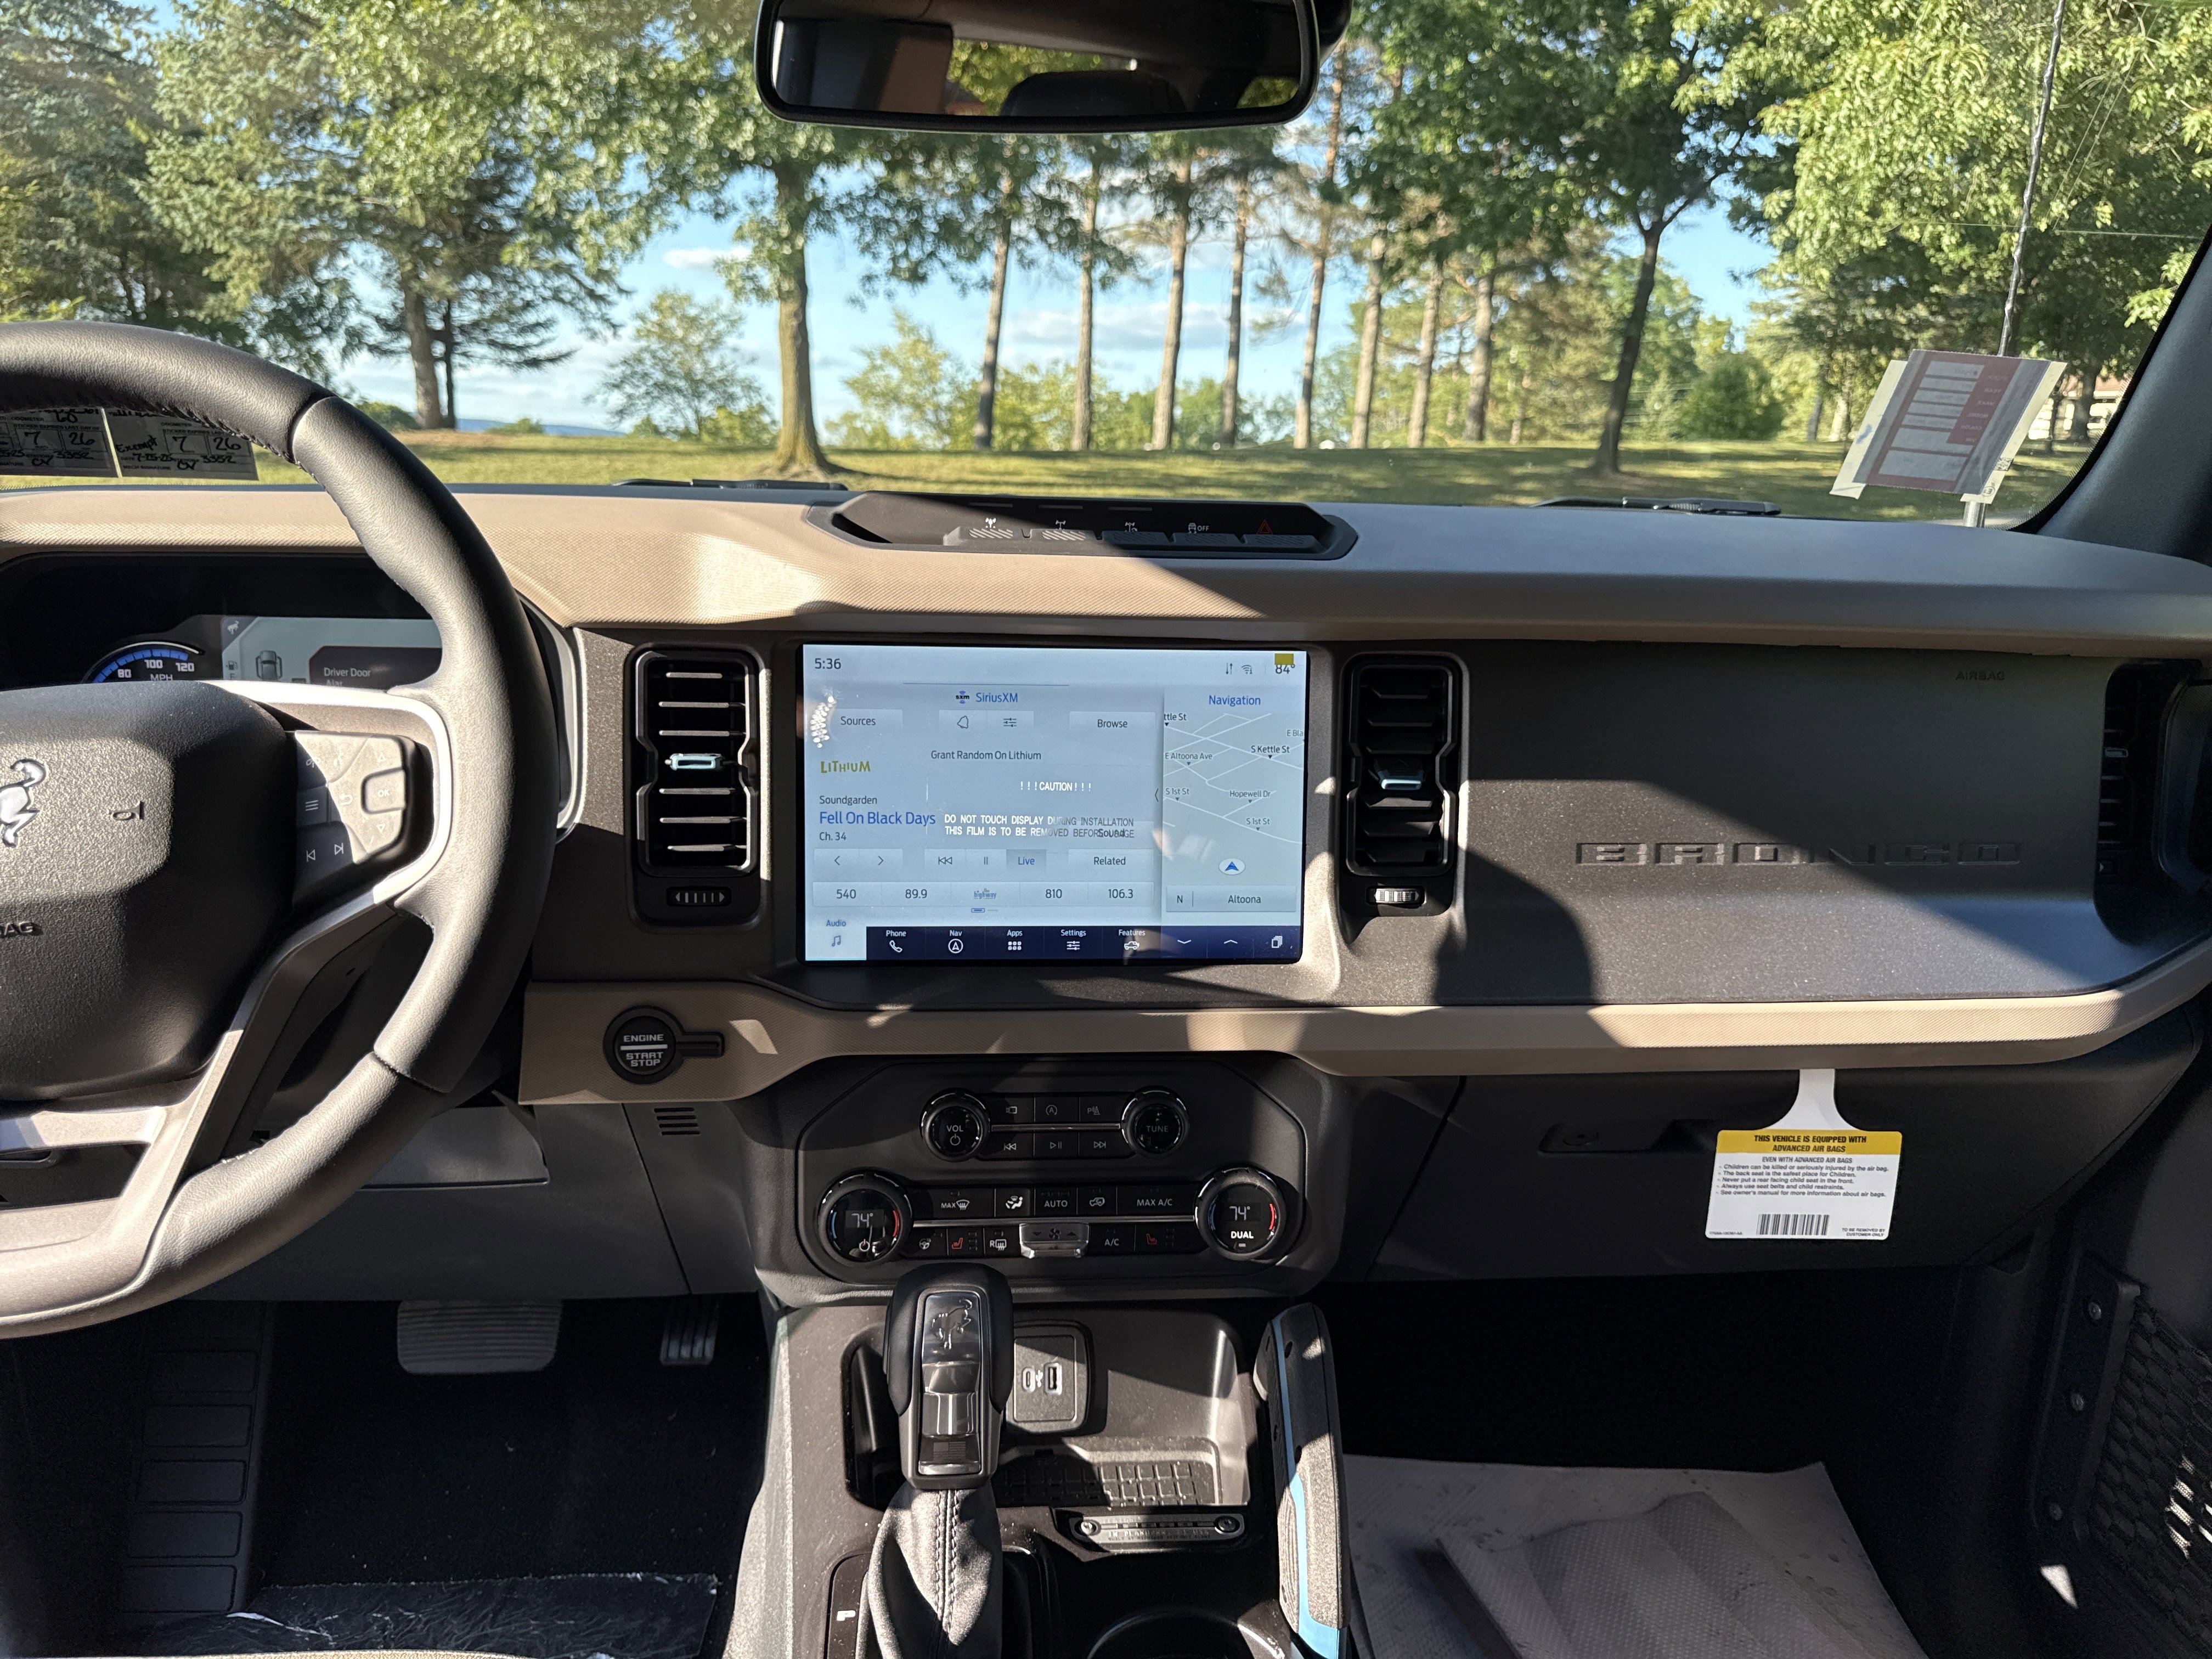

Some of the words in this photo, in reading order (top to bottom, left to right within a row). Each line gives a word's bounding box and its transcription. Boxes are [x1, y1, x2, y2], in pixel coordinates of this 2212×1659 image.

[213, 437, 241, 451] 26
[144, 659, 163, 669] 100
[176, 663, 195, 672] 120
[814, 658, 842, 670] 5:36
[117, 669, 132, 678] 80
[324, 667, 348, 676] Driver
[351, 668, 371, 677] Door
[975, 692, 1018, 703] SiriusXM
[1209, 695, 1261, 707] Navigation
[840, 716, 876, 726] Sources
[1097, 719, 1128, 728] Browse
[931, 750, 955, 759] Grant
[957, 750, 993, 759] Random
[995, 751, 1007, 759] On
[1009, 751, 1041, 760] Lithium
[1039, 782, 1073, 791] CAUTION
[377, 788, 390, 798] OK
[1229, 790, 1262, 798] Hopewell
[819, 795, 877, 806] Soundgarden
[820, 811, 843, 824] Fell
[846, 811, 864, 824] On
[867, 811, 902, 825] Black
[905, 812, 936, 827] Days
[944, 814, 956, 823] DO
[960, 815, 977, 823] NOT
[980, 815, 1007, 824] TOUCH
[1011, 815, 1043, 825] DISPLAY
[1047, 816, 1077, 826] DURING
[1081, 817, 1134, 826] INSTALLATION
[819, 832, 833, 841] Ch.
[835, 832, 847, 841] 34
[945, 826, 963, 836] THIS
[967, 827, 985, 836] FILM
[989, 827, 997, 836] IS
[1001, 827, 1012, 836] TO
[1015, 827, 1026, 836] BE
[1030, 828, 1069, 837] REMOVED
[1576, 843, 2021, 866] BRONCO
[1018, 856, 1035, 865] Live
[1093, 856, 1126, 866] Related
[836, 889, 856, 899] 540
[905, 889, 928, 899] 89.9
[974, 890, 997, 899] highway
[1045, 889, 1063, 899] 810
[1108, 889, 1133, 899] 106.3
[1177, 895, 1183, 904] N
[1228, 895, 1261, 904] Altoona
[1007, 929, 1023, 938] Apps
[1060, 929, 1087, 938] Settings
[623, 1034, 664, 1042] ENGINE
[626, 1051, 664, 1060] START
[630, 1059, 661, 1067] STOP
[946, 1125, 964, 1133] VOL
[1136, 1199, 1156, 1207] MAX
[1158, 1198, 1173, 1207] A/C
[1229, 1206, 1251, 1221] 74°
[851, 1212, 873, 1228] 74°
[1231, 1231, 1254, 1239] DUAL
[1104, 1238, 1119, 1246] A/C
